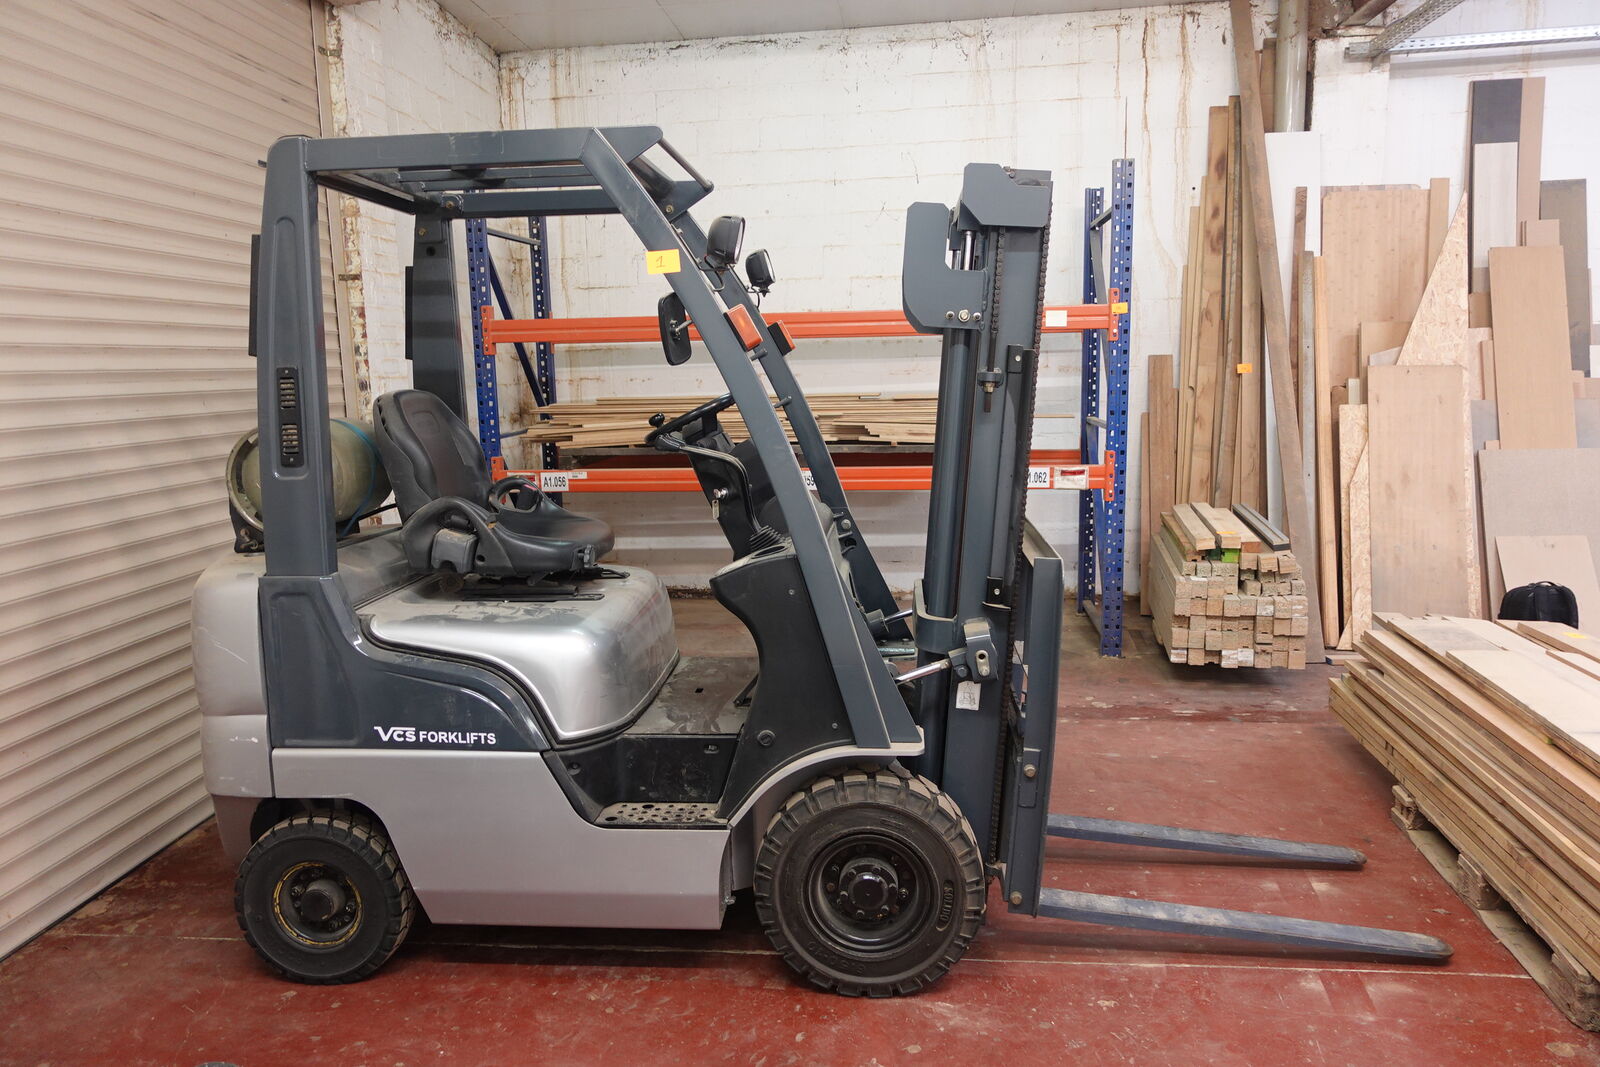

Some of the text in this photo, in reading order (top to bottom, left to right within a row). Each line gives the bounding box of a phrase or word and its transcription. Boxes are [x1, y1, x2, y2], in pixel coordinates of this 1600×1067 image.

[655, 255, 666, 268] 1
[543, 476, 567, 488] A1.056
[1027, 471, 1047, 484] 1.062
[419, 730, 497, 745] FORKLIFTS
